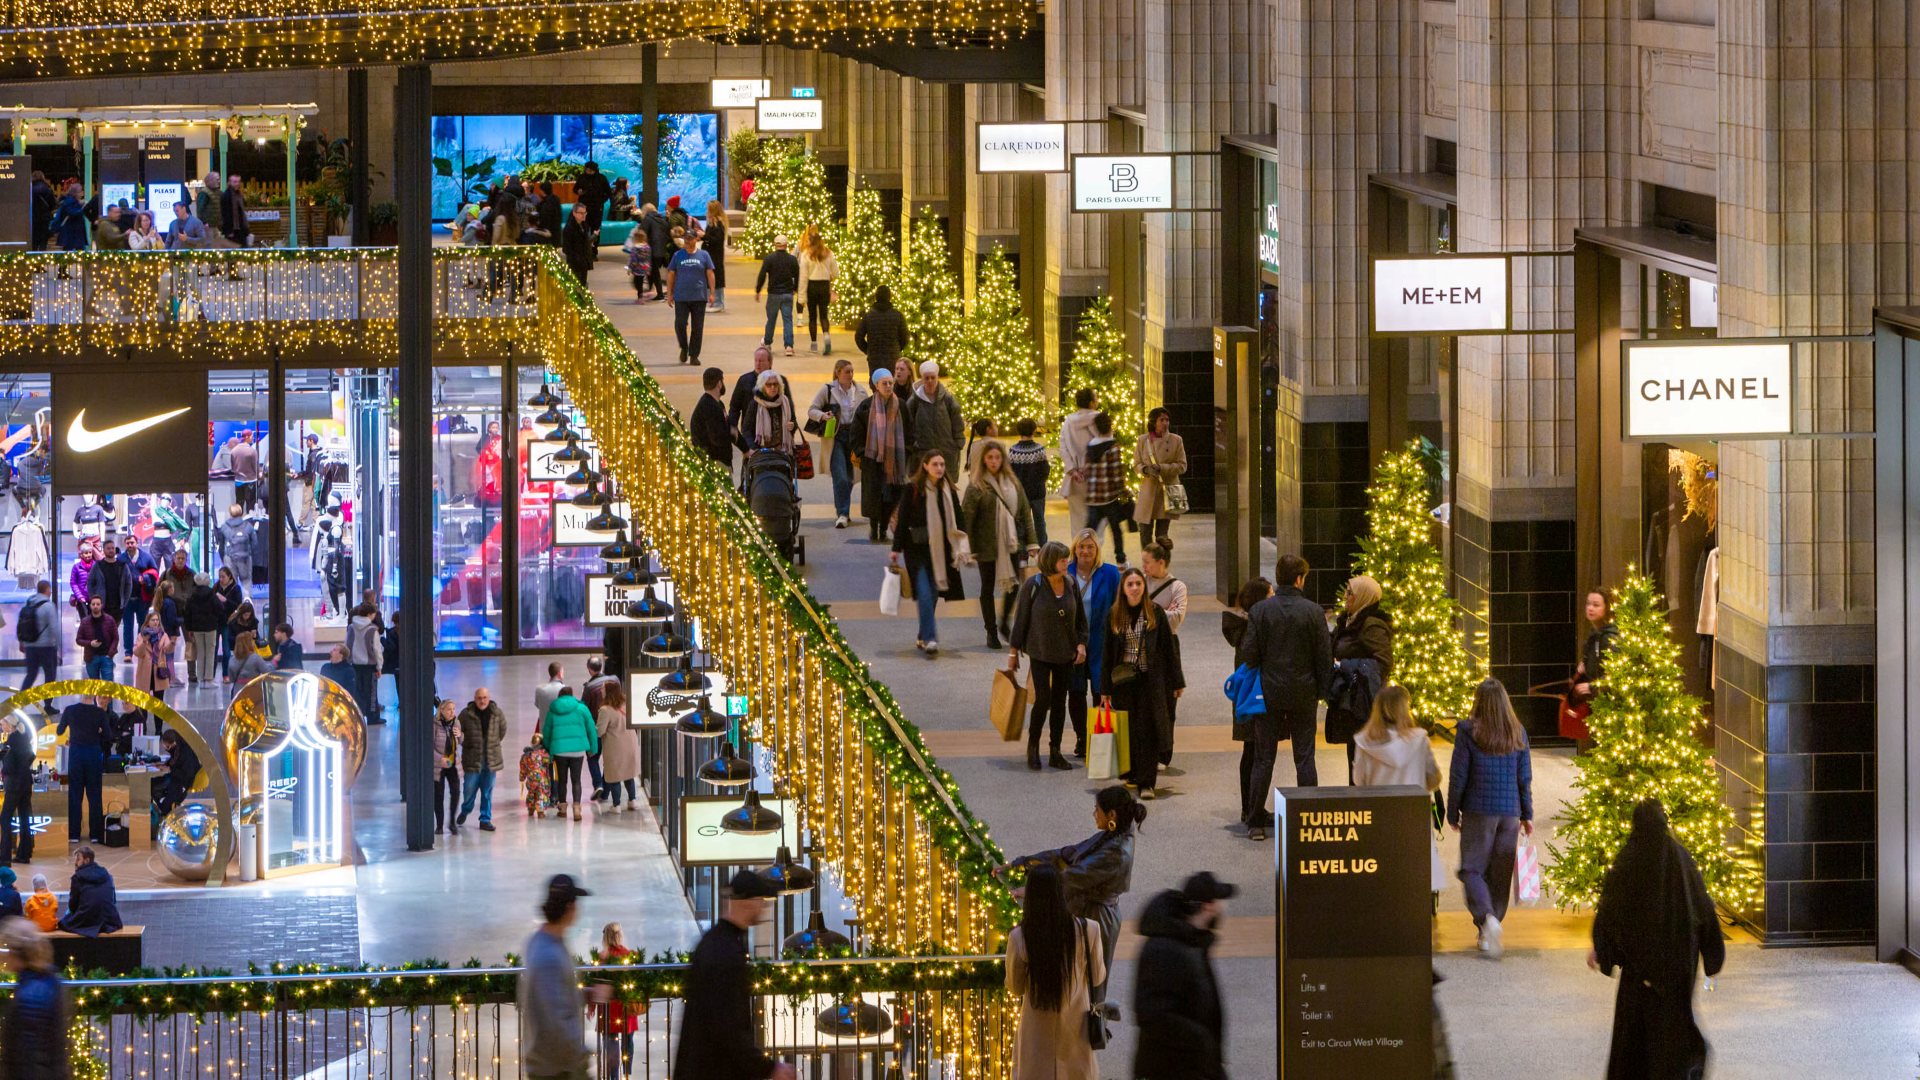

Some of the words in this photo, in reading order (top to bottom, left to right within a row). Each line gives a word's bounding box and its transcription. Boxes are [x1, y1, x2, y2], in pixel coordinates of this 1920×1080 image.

[985, 141, 1060, 154] CLARENDON
[1402, 287, 1482, 305] ME+EM
[1640, 377, 1779, 402] CHANEL
[605, 584, 629, 600] THE
[1300, 811, 1372, 826] TURBINE
[1300, 827, 1343, 842] HALL
[1345, 827, 1359, 841] A
[1300, 859, 1349, 875] LEVEL
[1351, 858, 1378, 873] UG
[1301, 984, 1316, 992] Lifts
[1301, 1011, 1322, 1020] Toilet
[1301, 1040, 1316, 1048] Exit
[1317, 1040, 1325, 1048] to
[1327, 1038, 1352, 1047] Circus
[1353, 1038, 1374, 1046] West
[1375, 1036, 1403, 1047] Village
